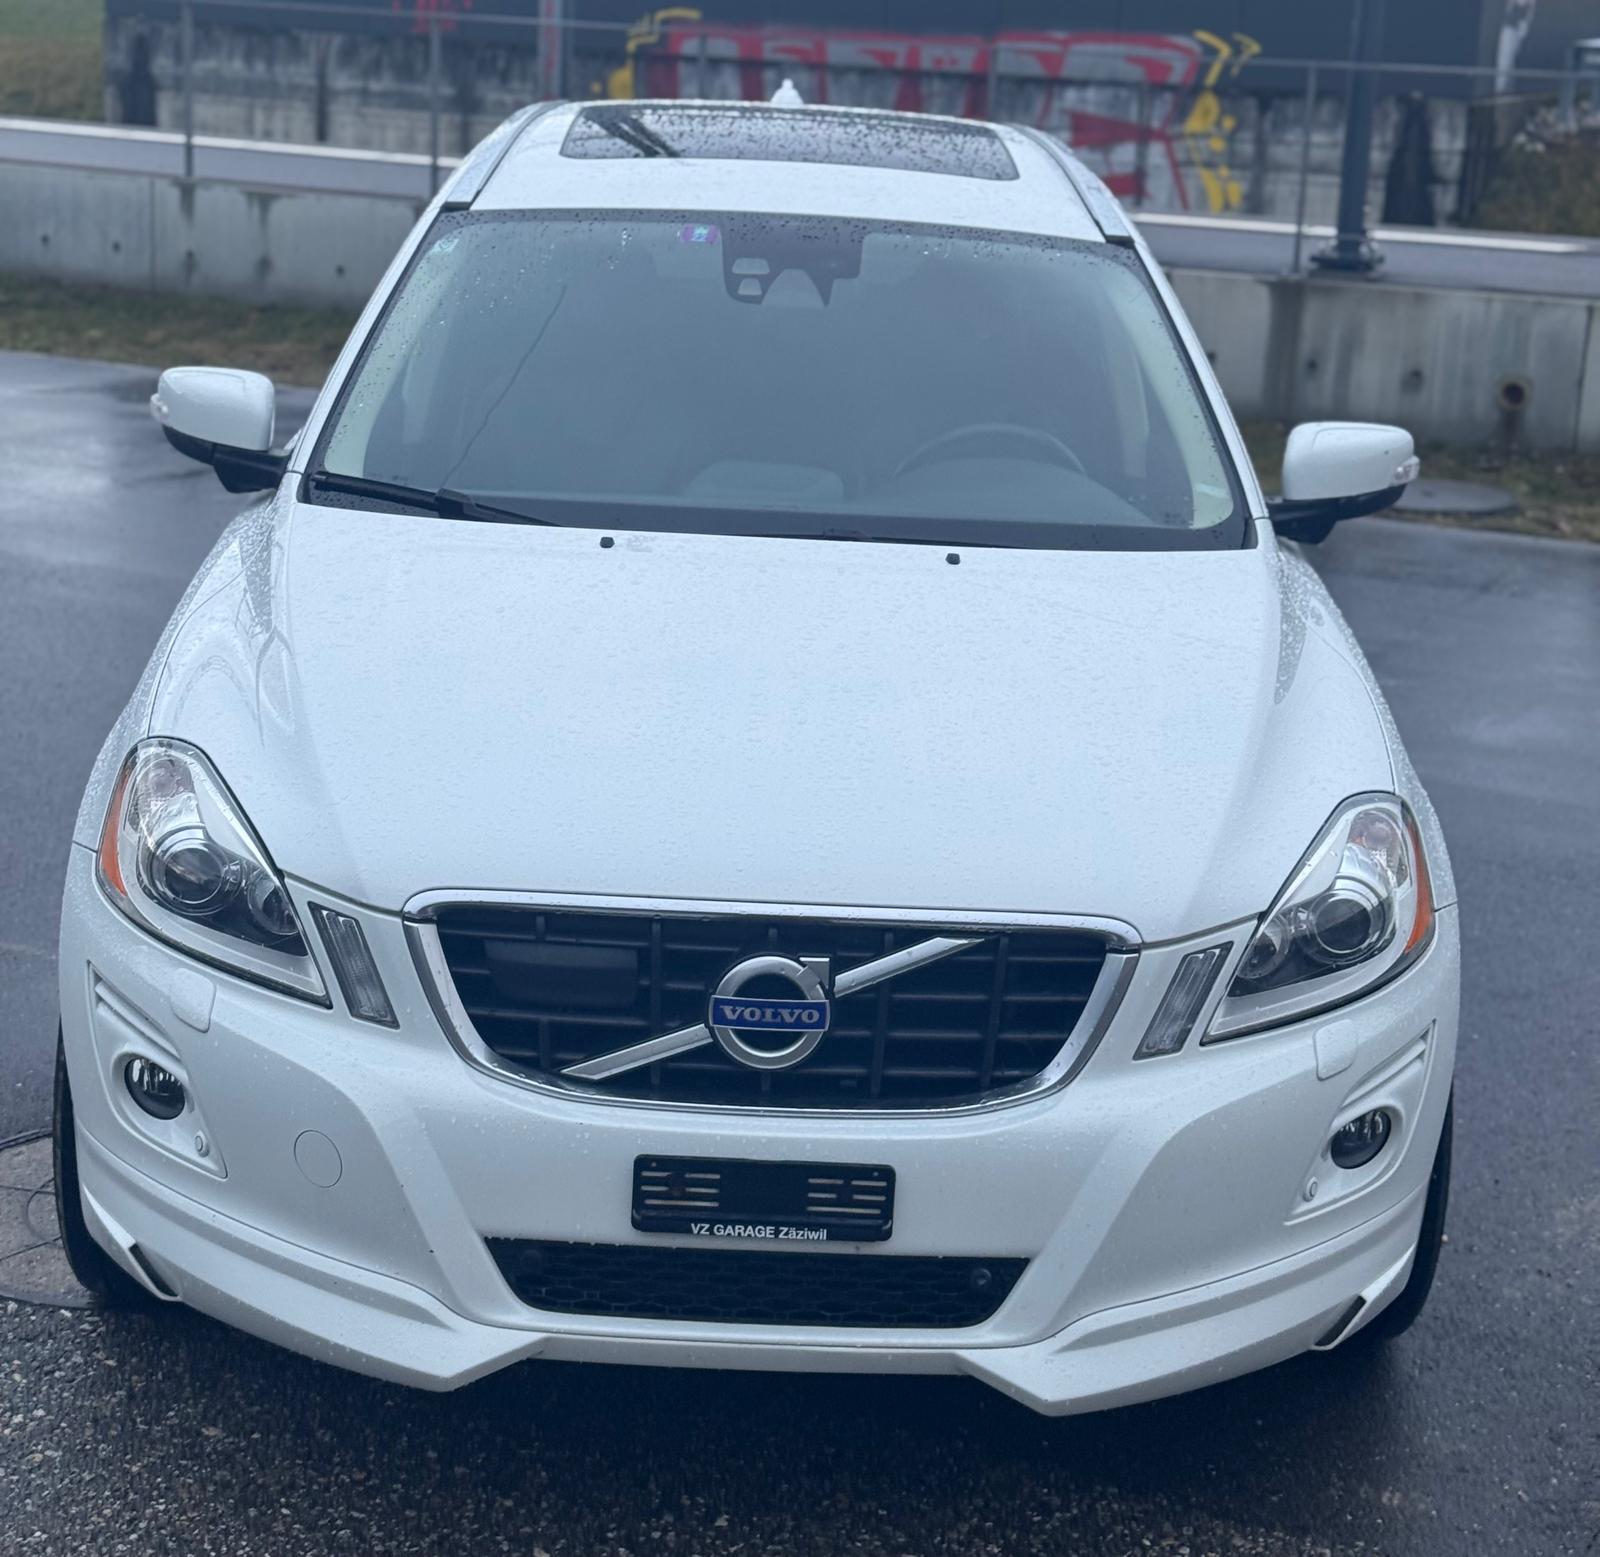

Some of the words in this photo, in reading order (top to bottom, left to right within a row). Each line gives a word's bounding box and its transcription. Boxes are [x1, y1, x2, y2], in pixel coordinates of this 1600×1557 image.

[719, 1005, 820, 1023] VOLVO
[690, 1223, 710, 1235] VZ
[713, 1224, 775, 1238] GARAGE
[778, 1226, 827, 1240] Zäziwil
